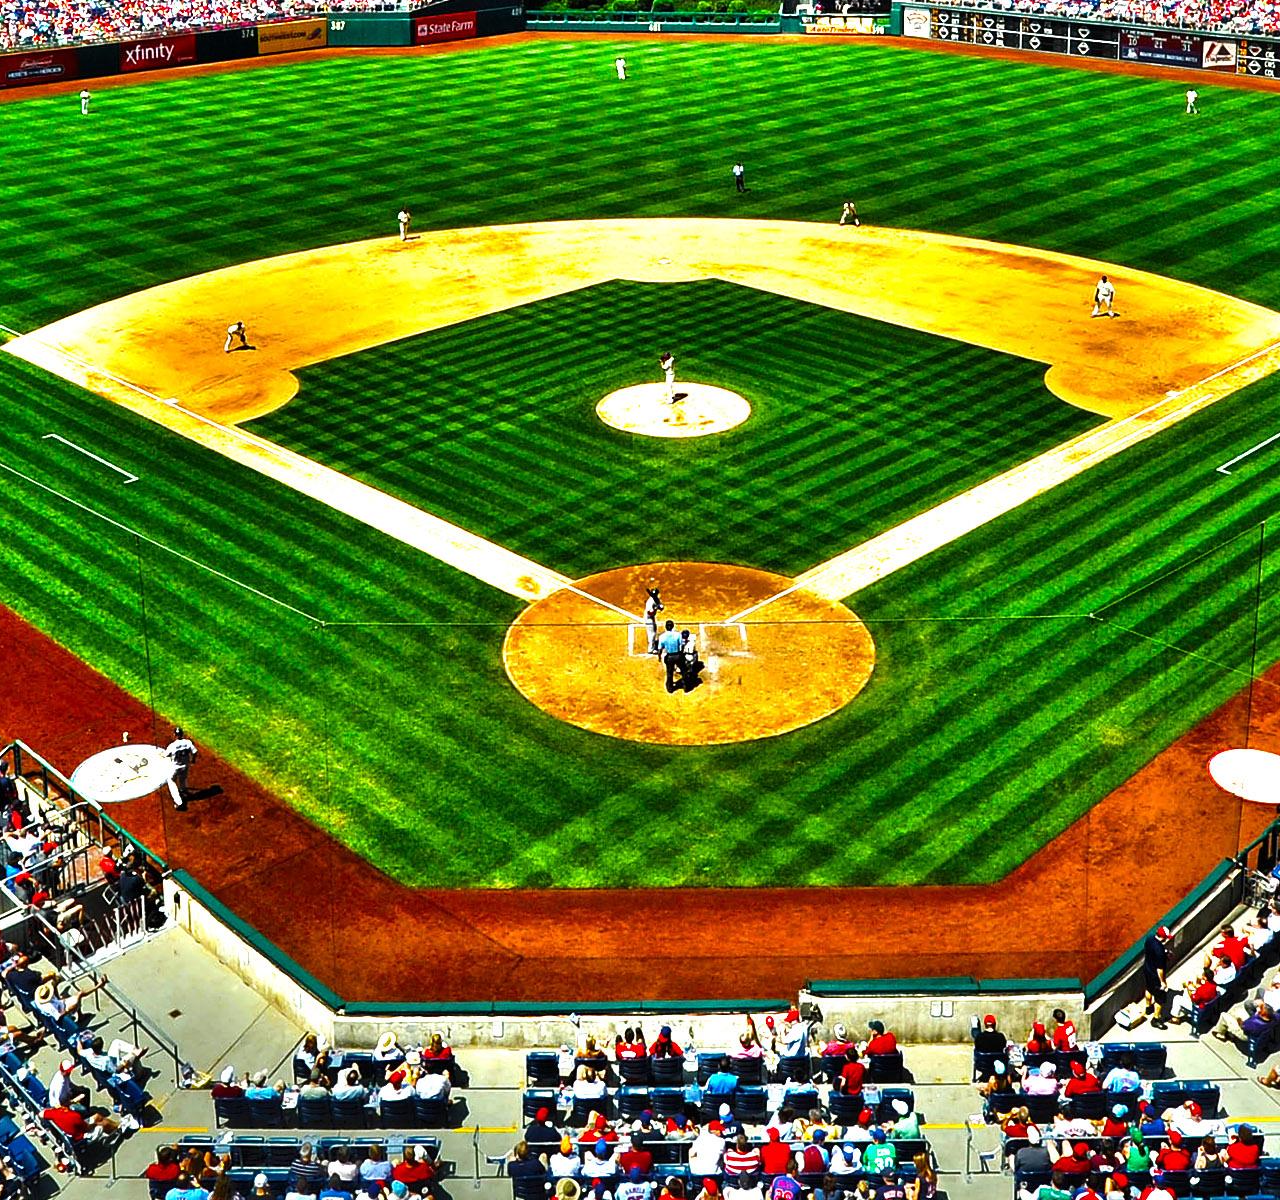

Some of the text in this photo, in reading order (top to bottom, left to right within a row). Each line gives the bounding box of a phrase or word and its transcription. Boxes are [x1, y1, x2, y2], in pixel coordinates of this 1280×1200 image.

[429, 19, 474, 36] State Farm
[125, 43, 175, 65] xfinity
